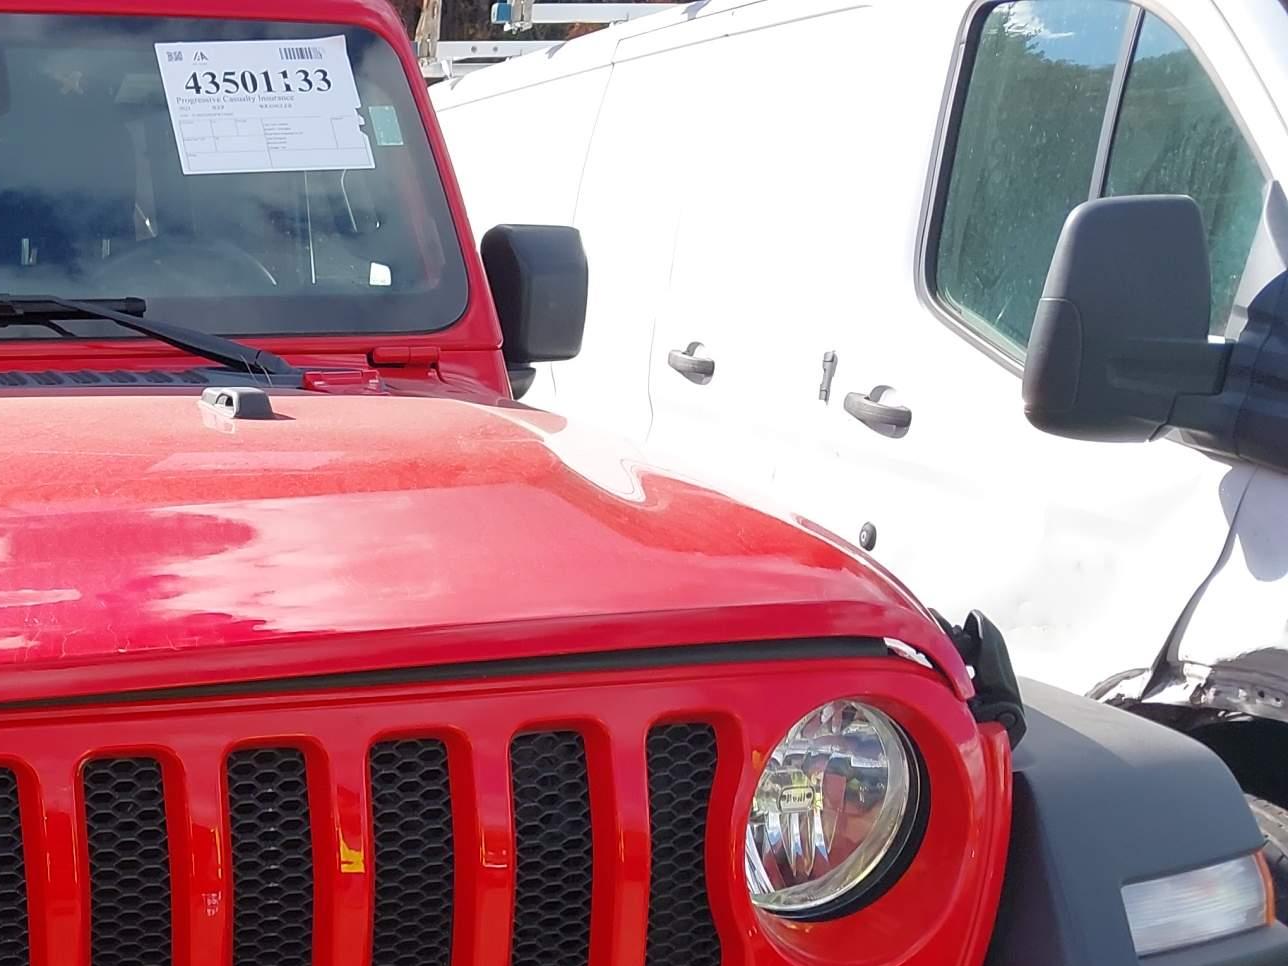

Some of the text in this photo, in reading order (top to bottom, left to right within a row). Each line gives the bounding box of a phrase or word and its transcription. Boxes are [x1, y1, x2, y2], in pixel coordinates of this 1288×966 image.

[185, 69, 332, 94] 43501133
[176, 94, 295, 105] Progressive Casualty Insurance
